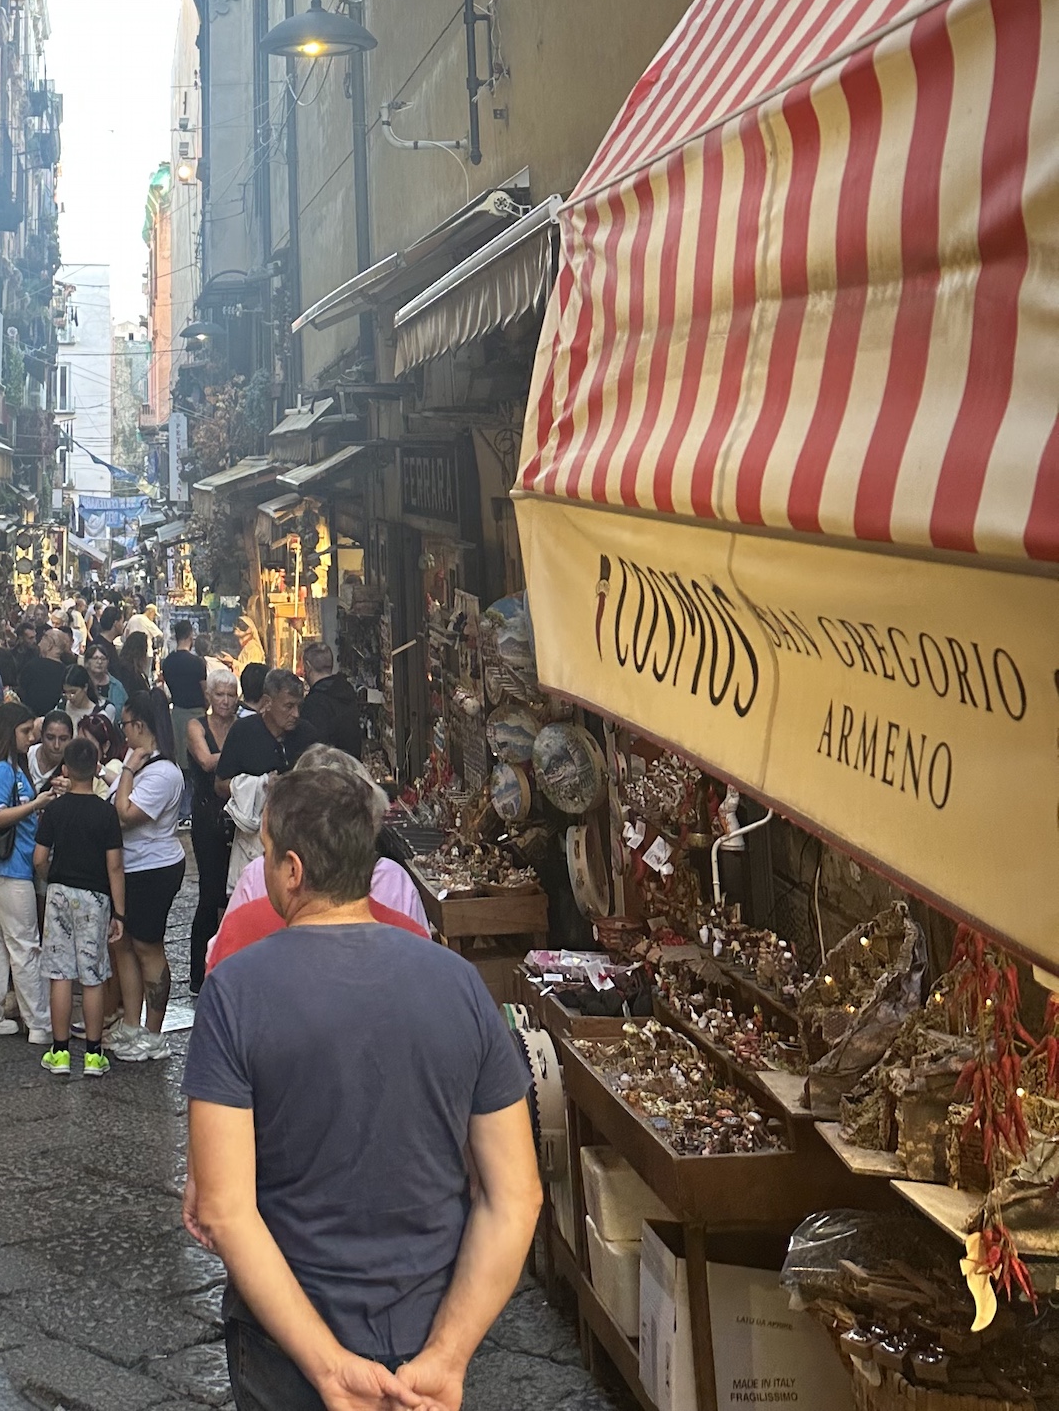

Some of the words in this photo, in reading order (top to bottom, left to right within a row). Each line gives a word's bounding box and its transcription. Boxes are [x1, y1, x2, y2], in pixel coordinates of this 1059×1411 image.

[403, 457, 454, 512] FERRARA
[615, 555, 760, 718] COSMOS
[753, 603, 823, 660] SAN
[817, 615, 1027, 721] GREGORIO
[817, 698, 953, 810] ARMENO
[730, 1392, 798, 1403] FRAGILISSIMO
[732, 1379, 758, 1390] MADE
[761, 1378, 771, 1388] IN
[773, 1378, 796, 1388] ITALY
